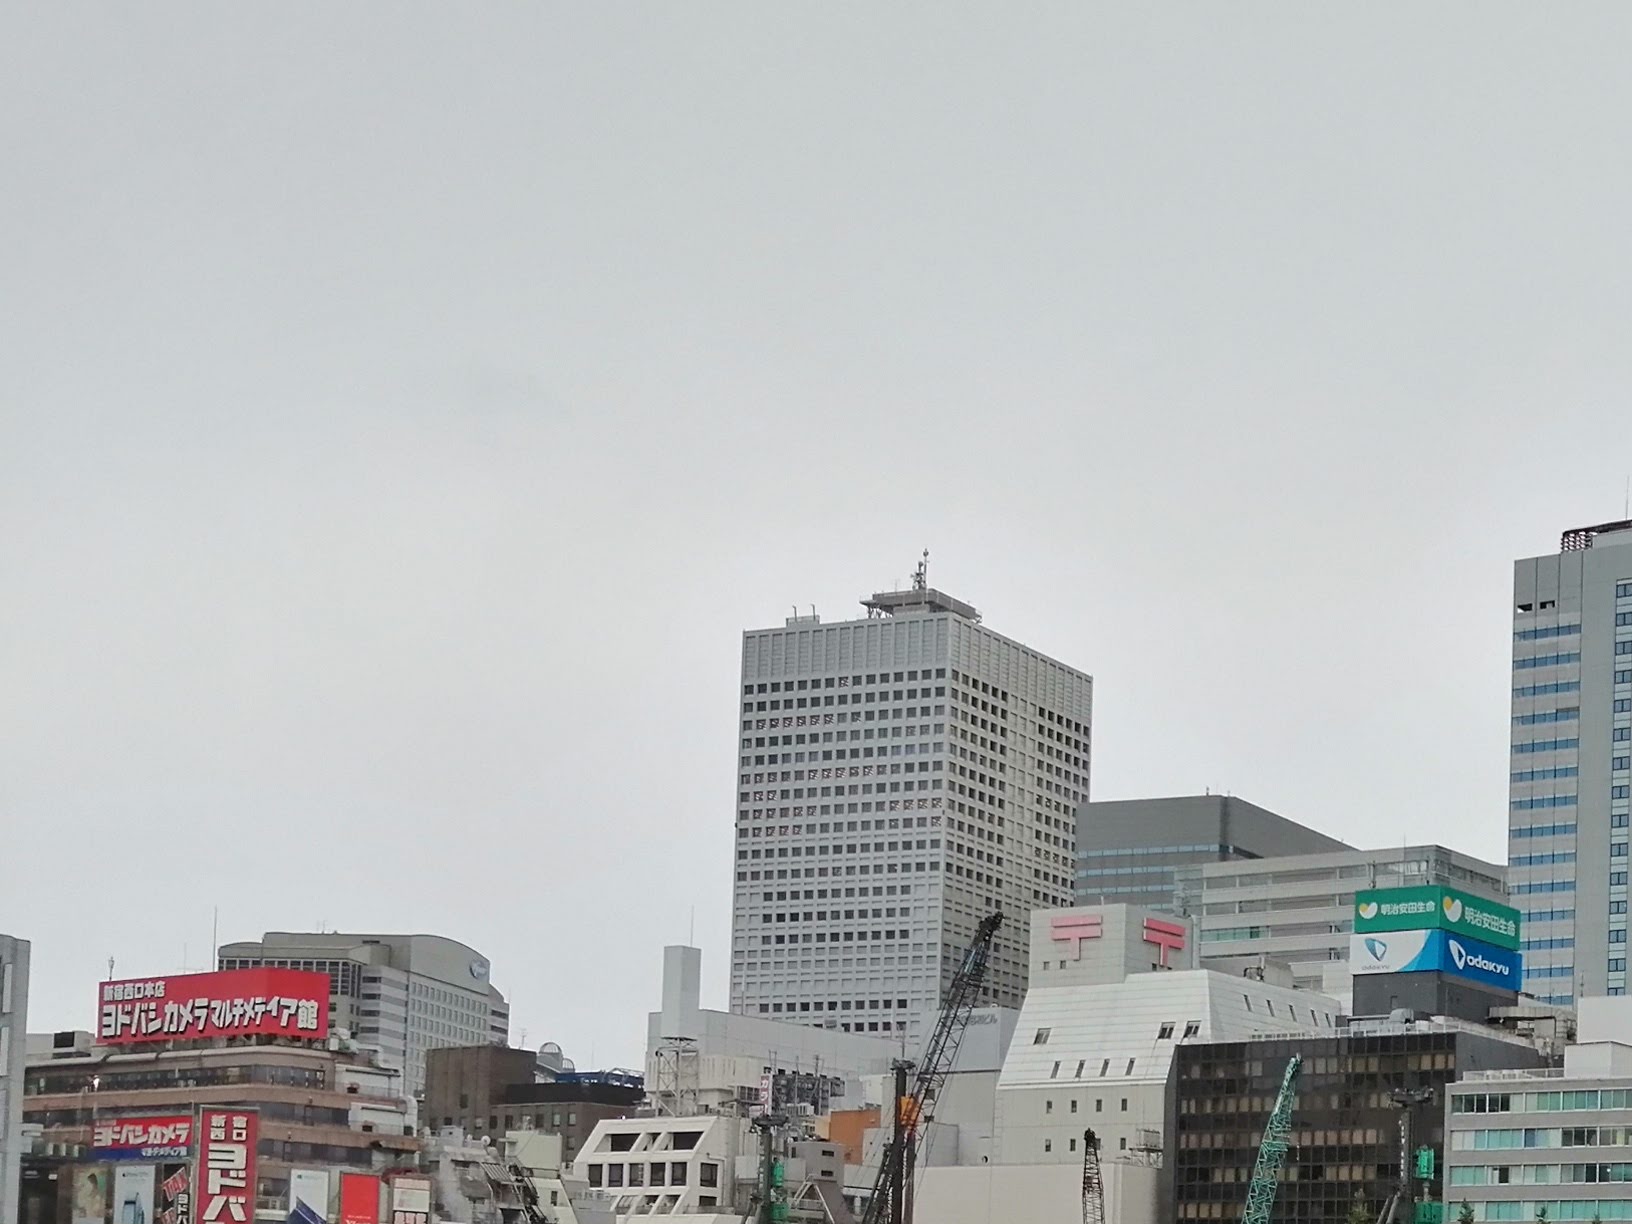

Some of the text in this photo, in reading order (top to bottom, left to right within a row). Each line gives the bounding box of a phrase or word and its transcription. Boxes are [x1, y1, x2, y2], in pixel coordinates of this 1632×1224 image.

[1381, 900, 1436, 916] 明治安田生命
[1464, 906, 1516, 937] 明治安田生命
[1467, 955, 1510, 976] odakyu
[103, 981, 165, 1001] 新宿西口本店
[93, 1122, 191, 1148] ヨドバシカメラ
